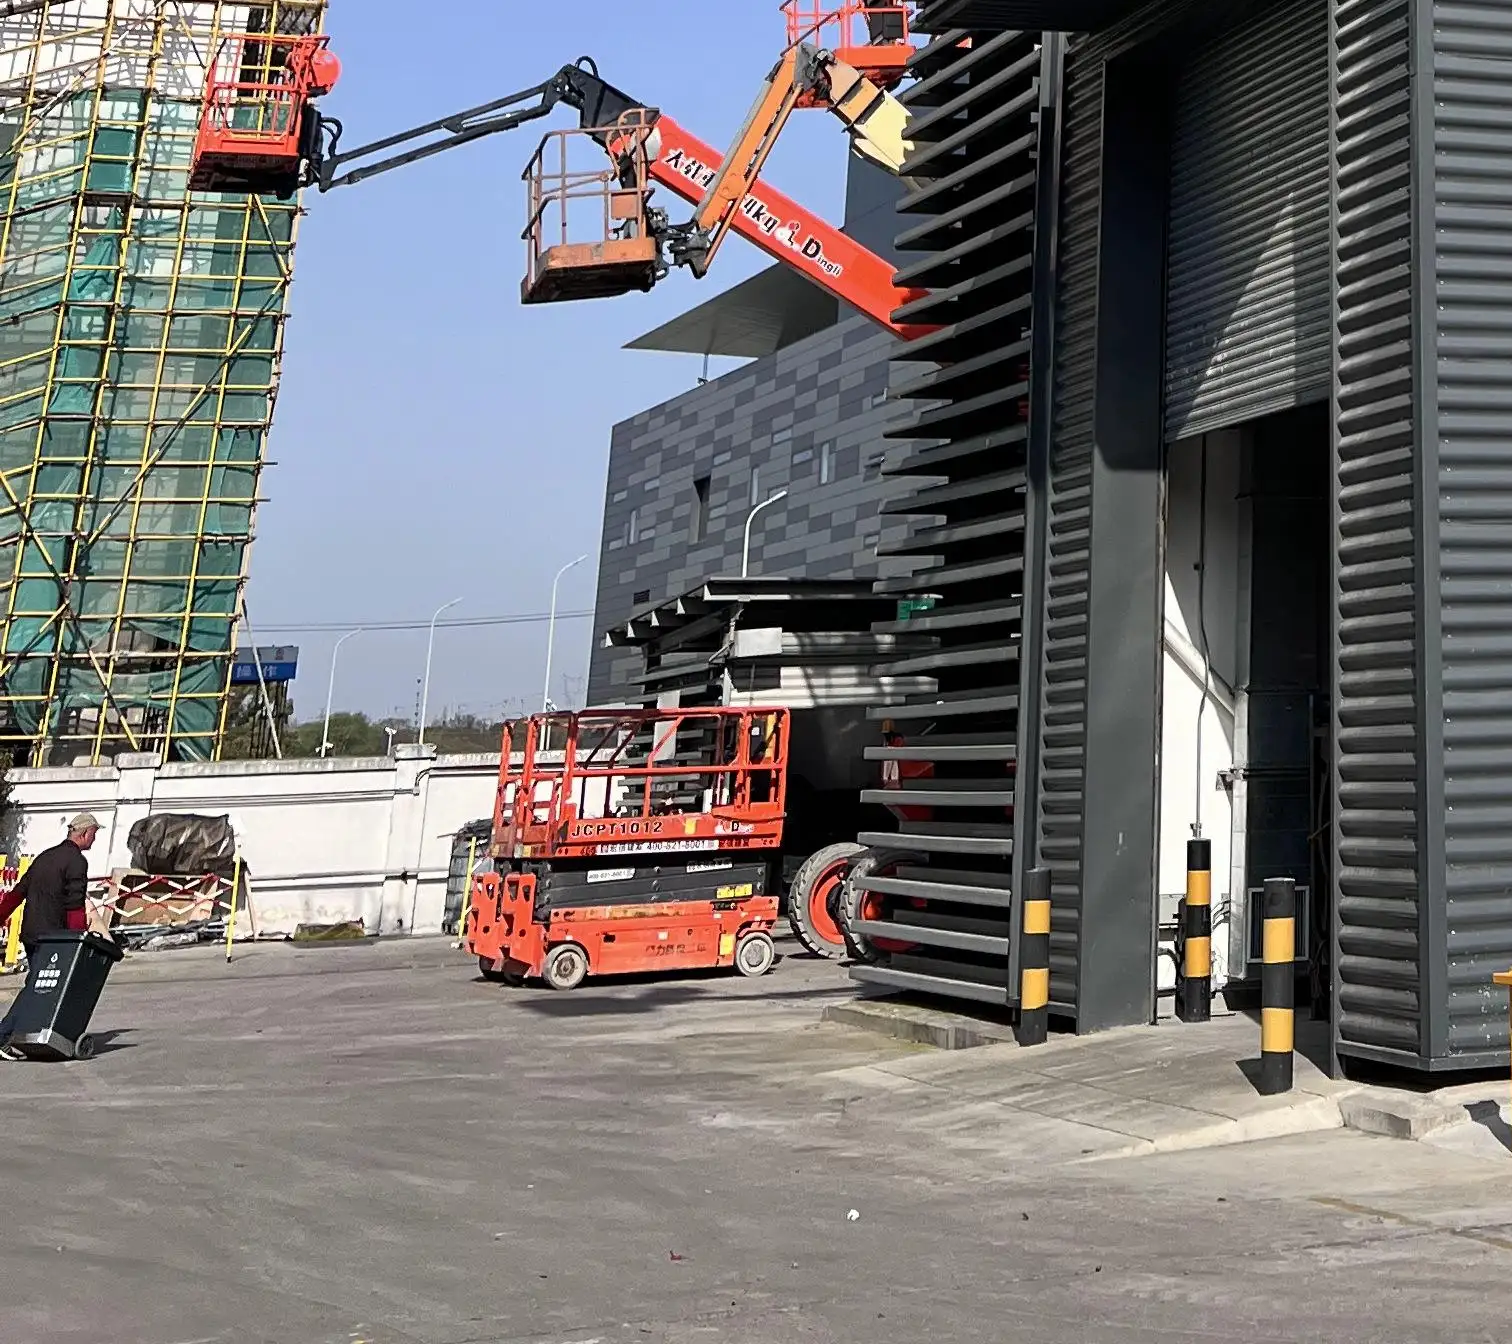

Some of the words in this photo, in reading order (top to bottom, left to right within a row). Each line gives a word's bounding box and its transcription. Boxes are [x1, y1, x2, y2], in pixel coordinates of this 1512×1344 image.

[742, 195, 780, 234] 4kg
[801, 235, 842, 277] Dingli
[571, 821, 664, 837] JCPT1012
